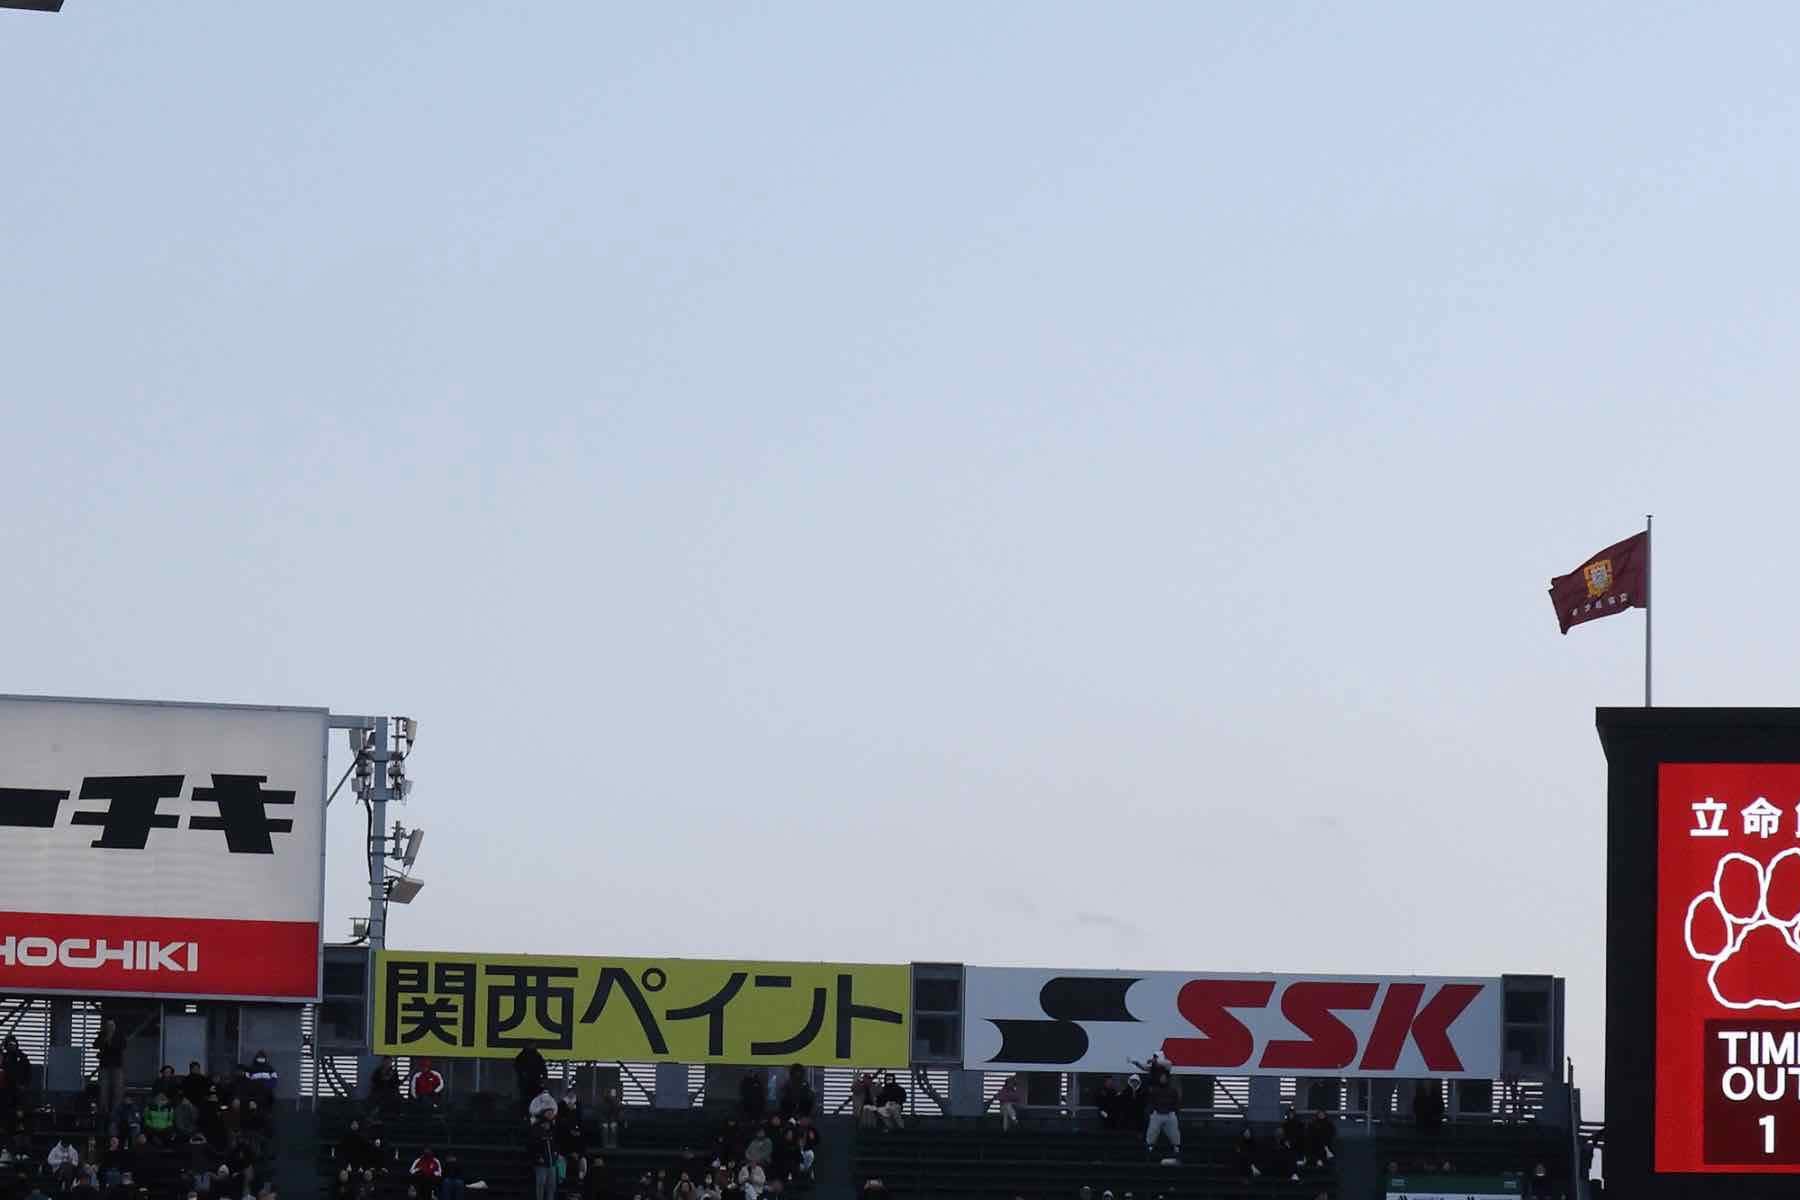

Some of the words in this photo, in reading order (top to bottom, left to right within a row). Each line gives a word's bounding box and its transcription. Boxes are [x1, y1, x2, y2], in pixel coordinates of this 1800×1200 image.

[384, 961, 904, 1060] 関西ペイント
[1162, 978, 1486, 1072] SSK
[1760, 1116, 1776, 1153] 1
